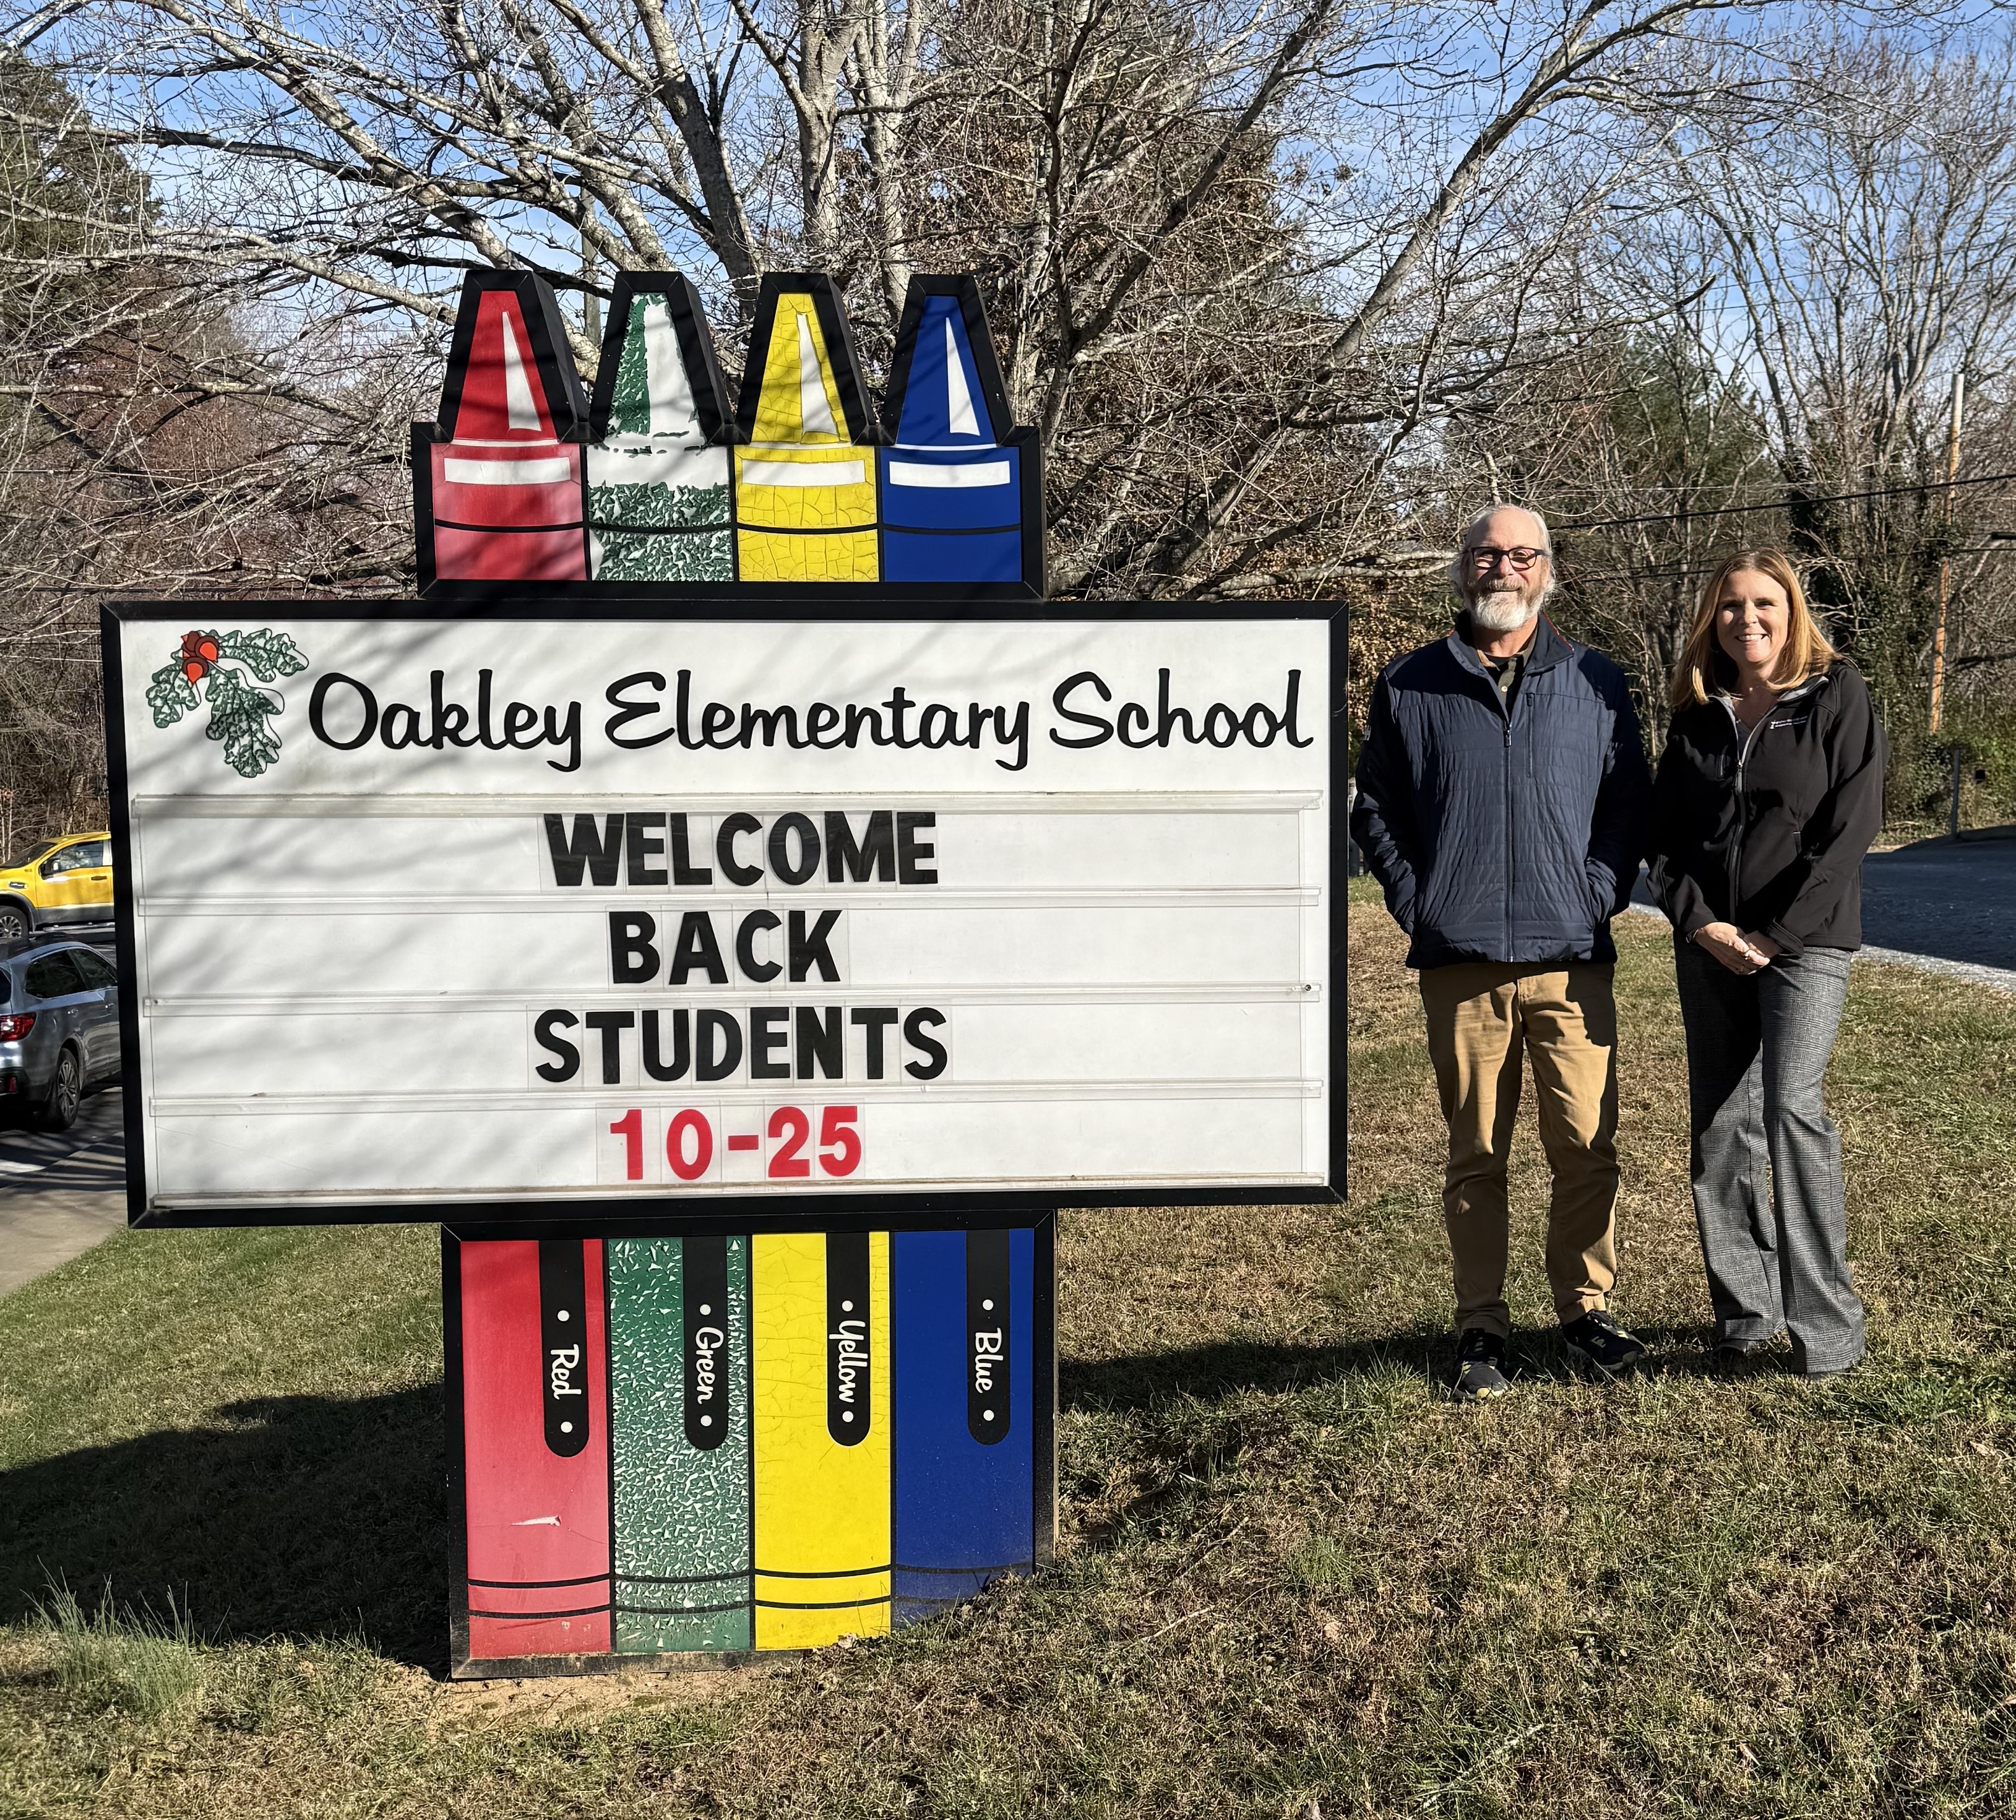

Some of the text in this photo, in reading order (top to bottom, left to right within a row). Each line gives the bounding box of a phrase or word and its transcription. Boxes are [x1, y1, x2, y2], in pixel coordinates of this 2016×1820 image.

[308, 668, 1314, 772] Oakley Elementary School
[543, 811, 938, 886] WELCOME
[609, 909, 843, 985] BACK
[534, 1007, 948, 1084] STUDENTS
[610, 1106, 861, 1180] 10-25
[550, 1344, 582, 1400] Red
[695, 1326, 724, 1404] Green
[829, 1320, 868, 1403] Yellow
[975, 1327, 1004, 1394] Blue
